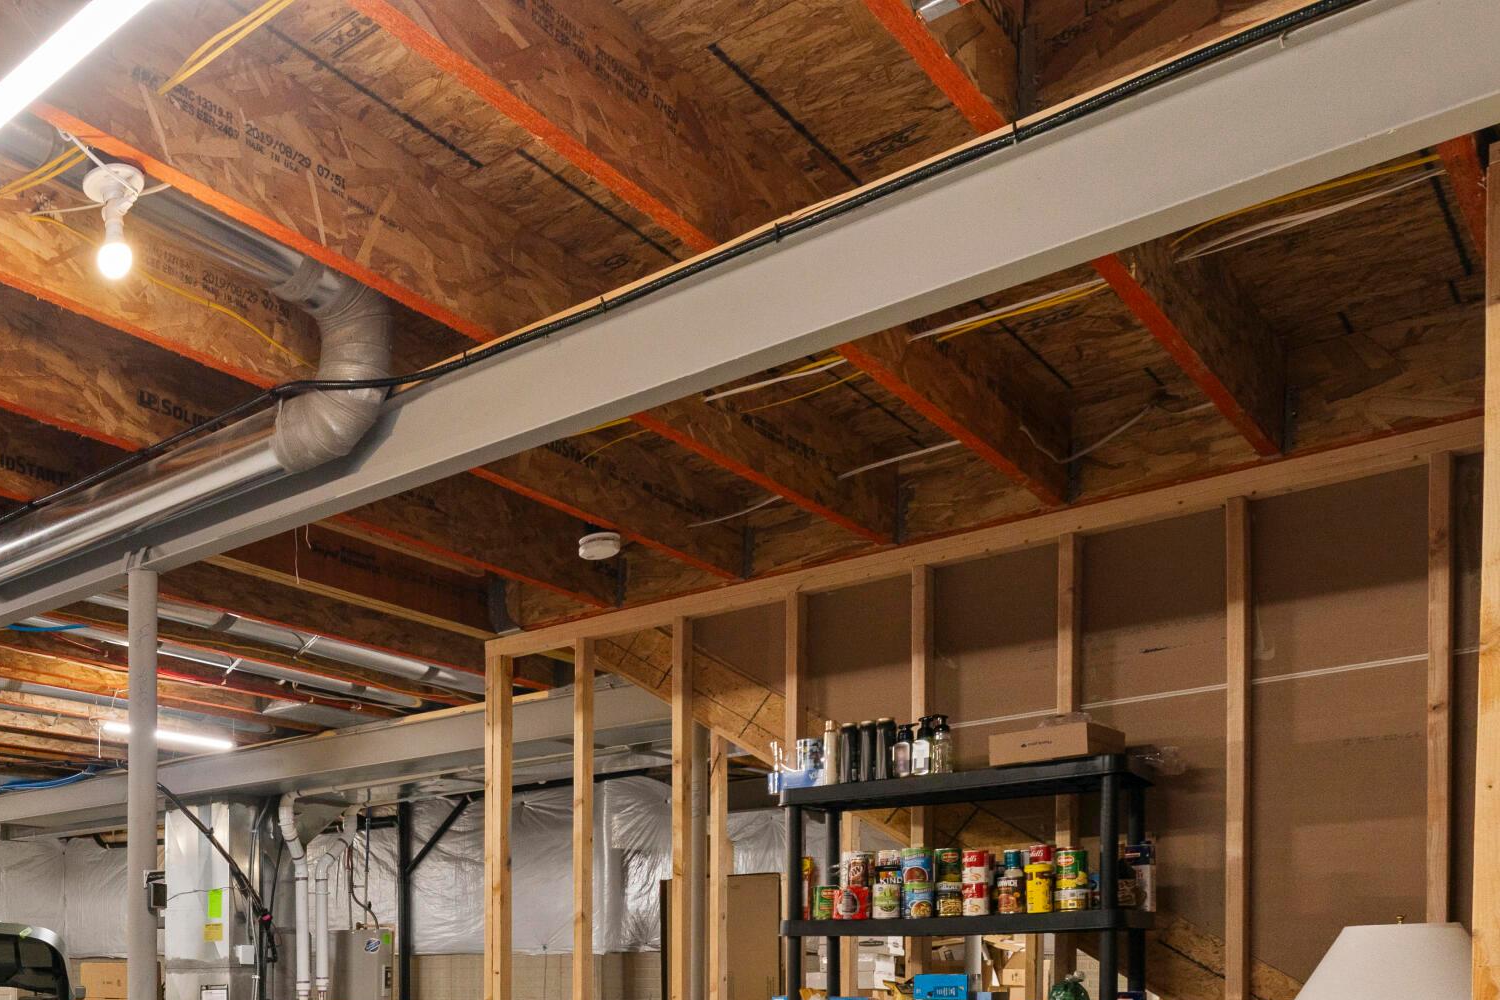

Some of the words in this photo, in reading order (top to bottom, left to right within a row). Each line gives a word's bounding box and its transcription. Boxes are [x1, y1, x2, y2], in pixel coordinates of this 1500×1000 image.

[244, 124, 312, 169] 2019/08/29
[269, 151, 281, 164] IN
[284, 159, 300, 174] USA
[880, 876, 902, 884] KIND
